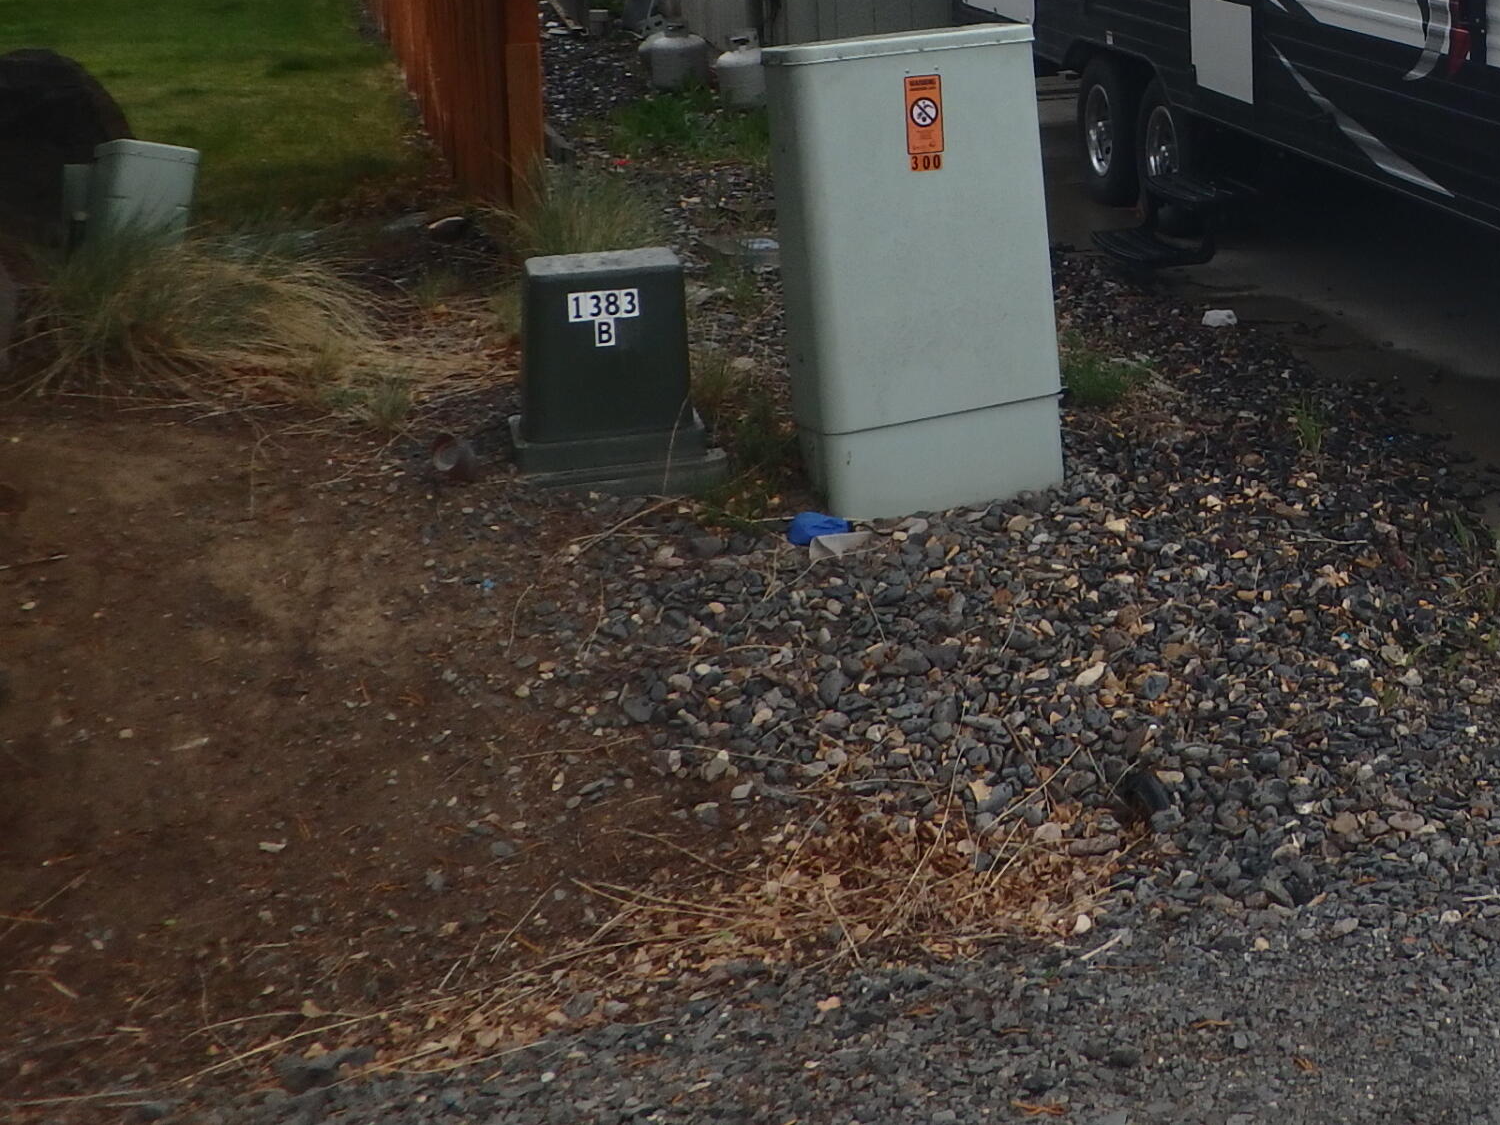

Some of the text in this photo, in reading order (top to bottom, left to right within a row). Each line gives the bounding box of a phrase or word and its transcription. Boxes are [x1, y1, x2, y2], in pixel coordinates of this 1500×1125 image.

[911, 154, 941, 171] 300
[572, 291, 637, 319] 1383
[597, 321, 613, 344] B
